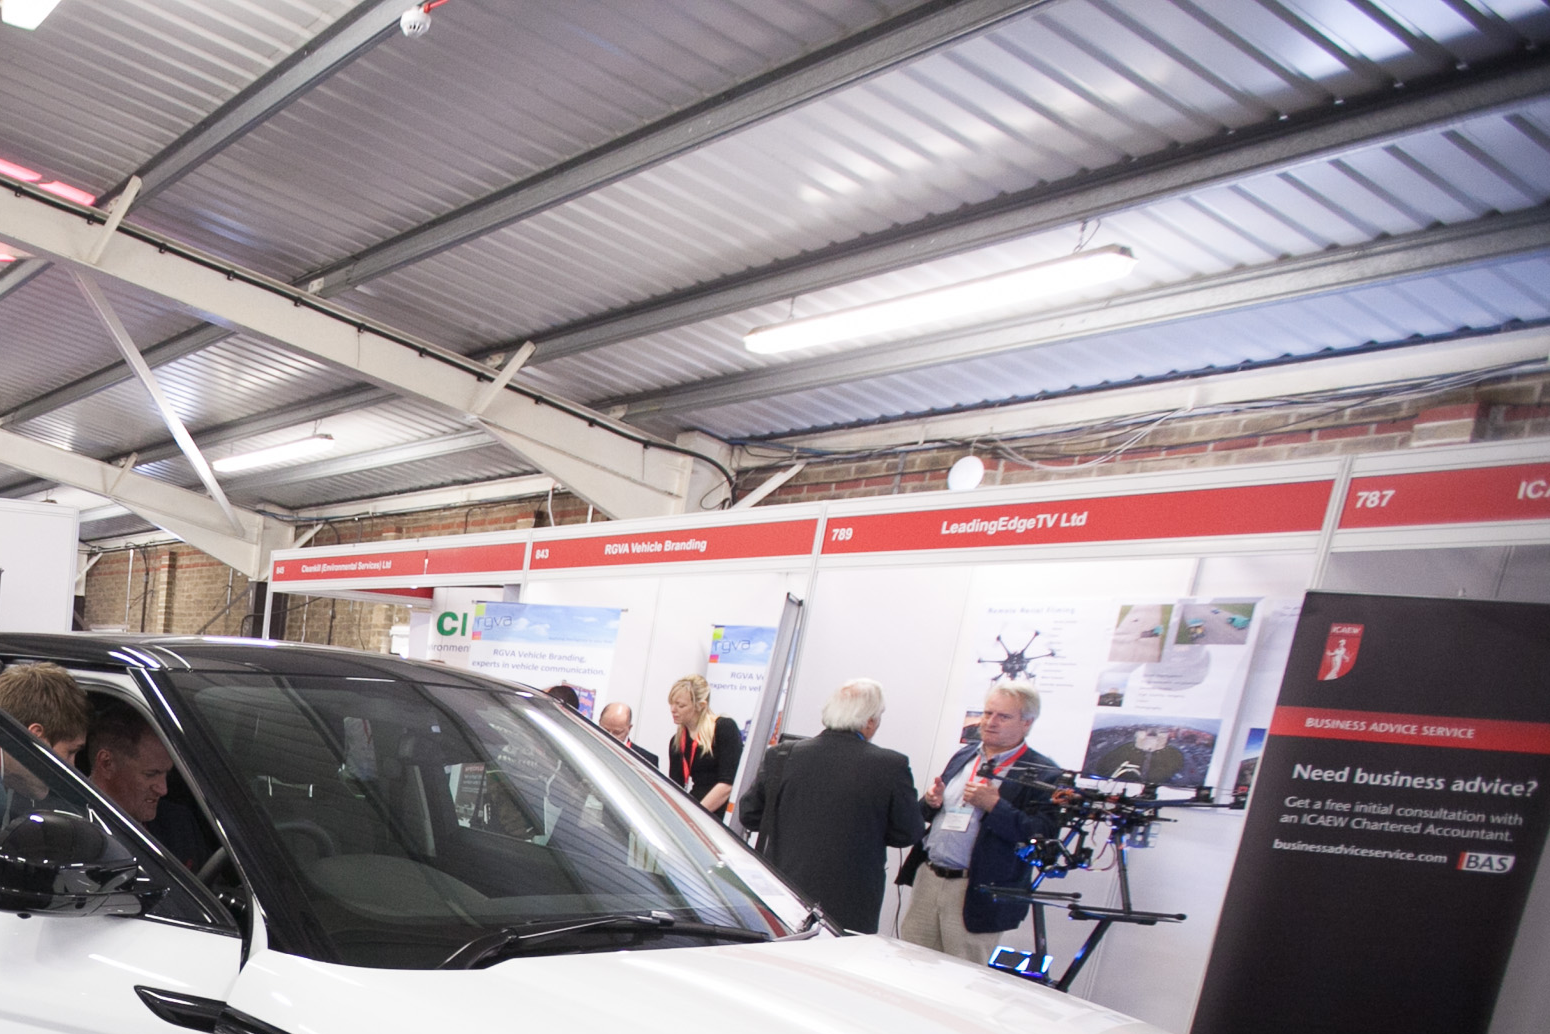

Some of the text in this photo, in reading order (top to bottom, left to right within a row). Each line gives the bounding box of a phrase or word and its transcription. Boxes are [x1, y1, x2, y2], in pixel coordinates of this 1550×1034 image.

[1355, 489, 1396, 509] 787
[831, 511, 1088, 542] 789 LeadingEdgeTV Ltd
[535, 539, 707, 559] 843 RGVA Vehicle Branding
[382, 560, 392, 569] Ltd
[476, 615, 513, 631] rgva
[1331, 626, 1361, 635] ICAEW
[493, 648, 516, 658] RGVA
[518, 650, 547, 660] Vehicle
[714, 639, 750, 654] rgva
[472, 660, 500, 670] experts
[502, 661, 510, 669] in
[511, 661, 540, 671] vehicle
[1305, 717, 1476, 739] BUSINESS ADVICE SERVICE
[1291, 763, 1539, 798] Need business advice?
[1284, 796, 1524, 826] Get a free initial consultation with
[1279, 813, 1513, 842] an ICAEW Chartered Accountant.
[1272, 838, 1512, 872] businessadviceservice.com BAS
